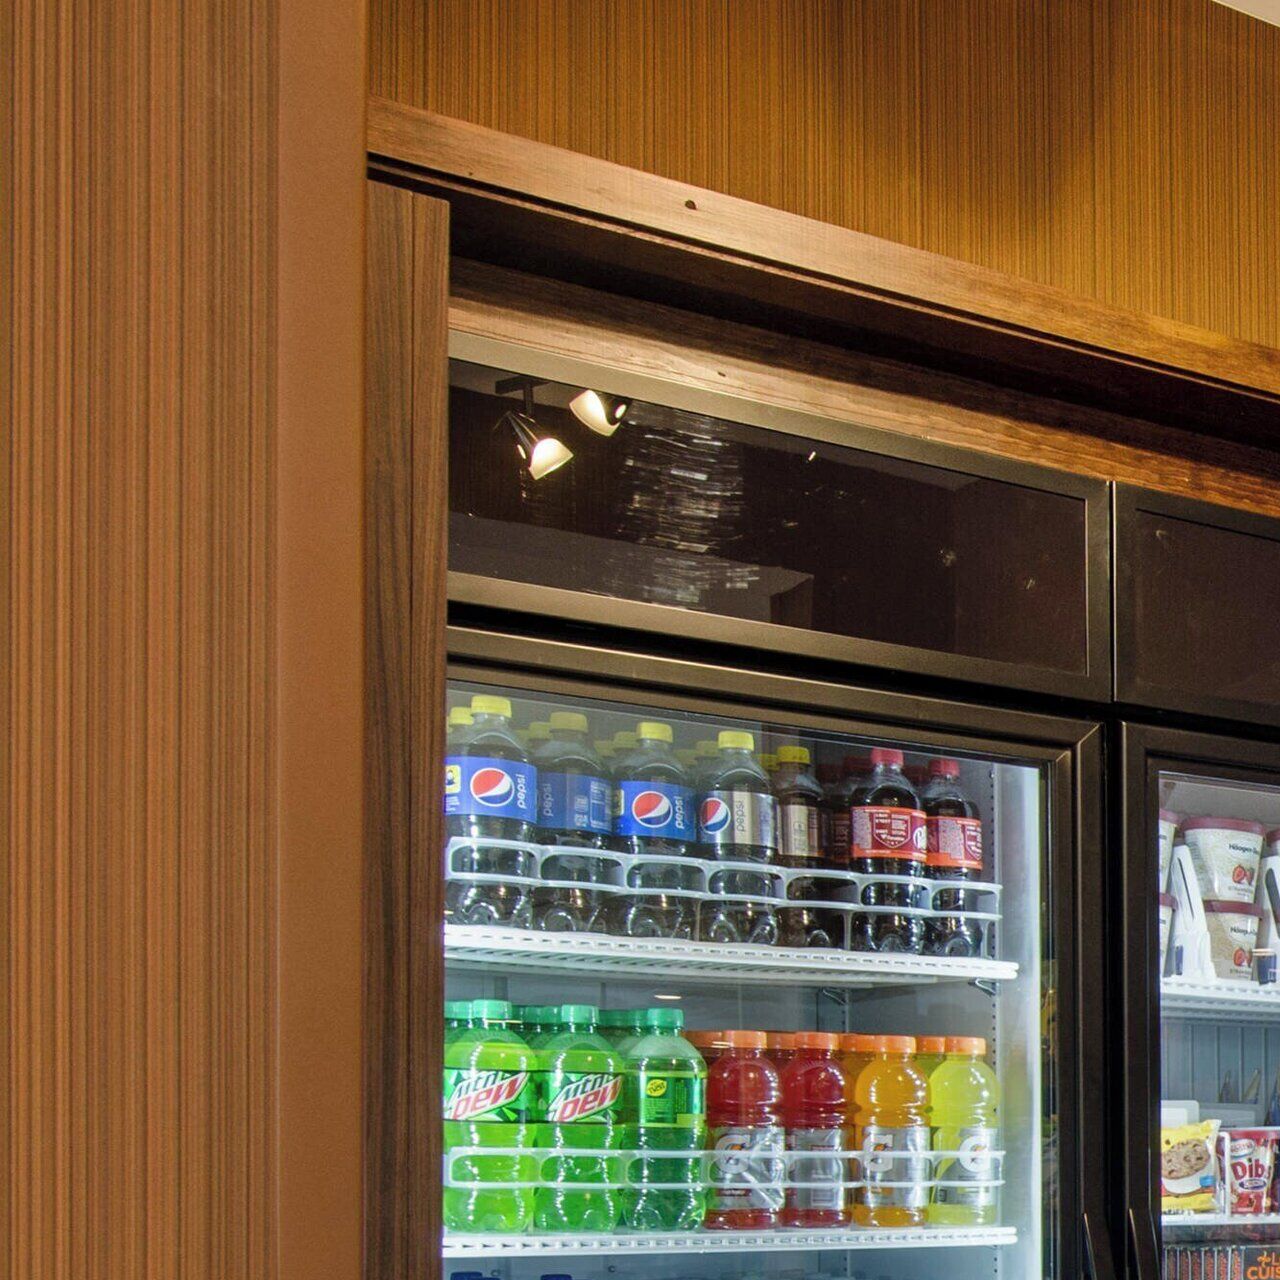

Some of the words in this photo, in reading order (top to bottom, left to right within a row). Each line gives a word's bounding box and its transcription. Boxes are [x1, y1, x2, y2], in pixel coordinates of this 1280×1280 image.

[514, 773, 527, 811] pepsi
[674, 796, 685, 830] pepsi
[737, 800, 748, 832] pepsi
